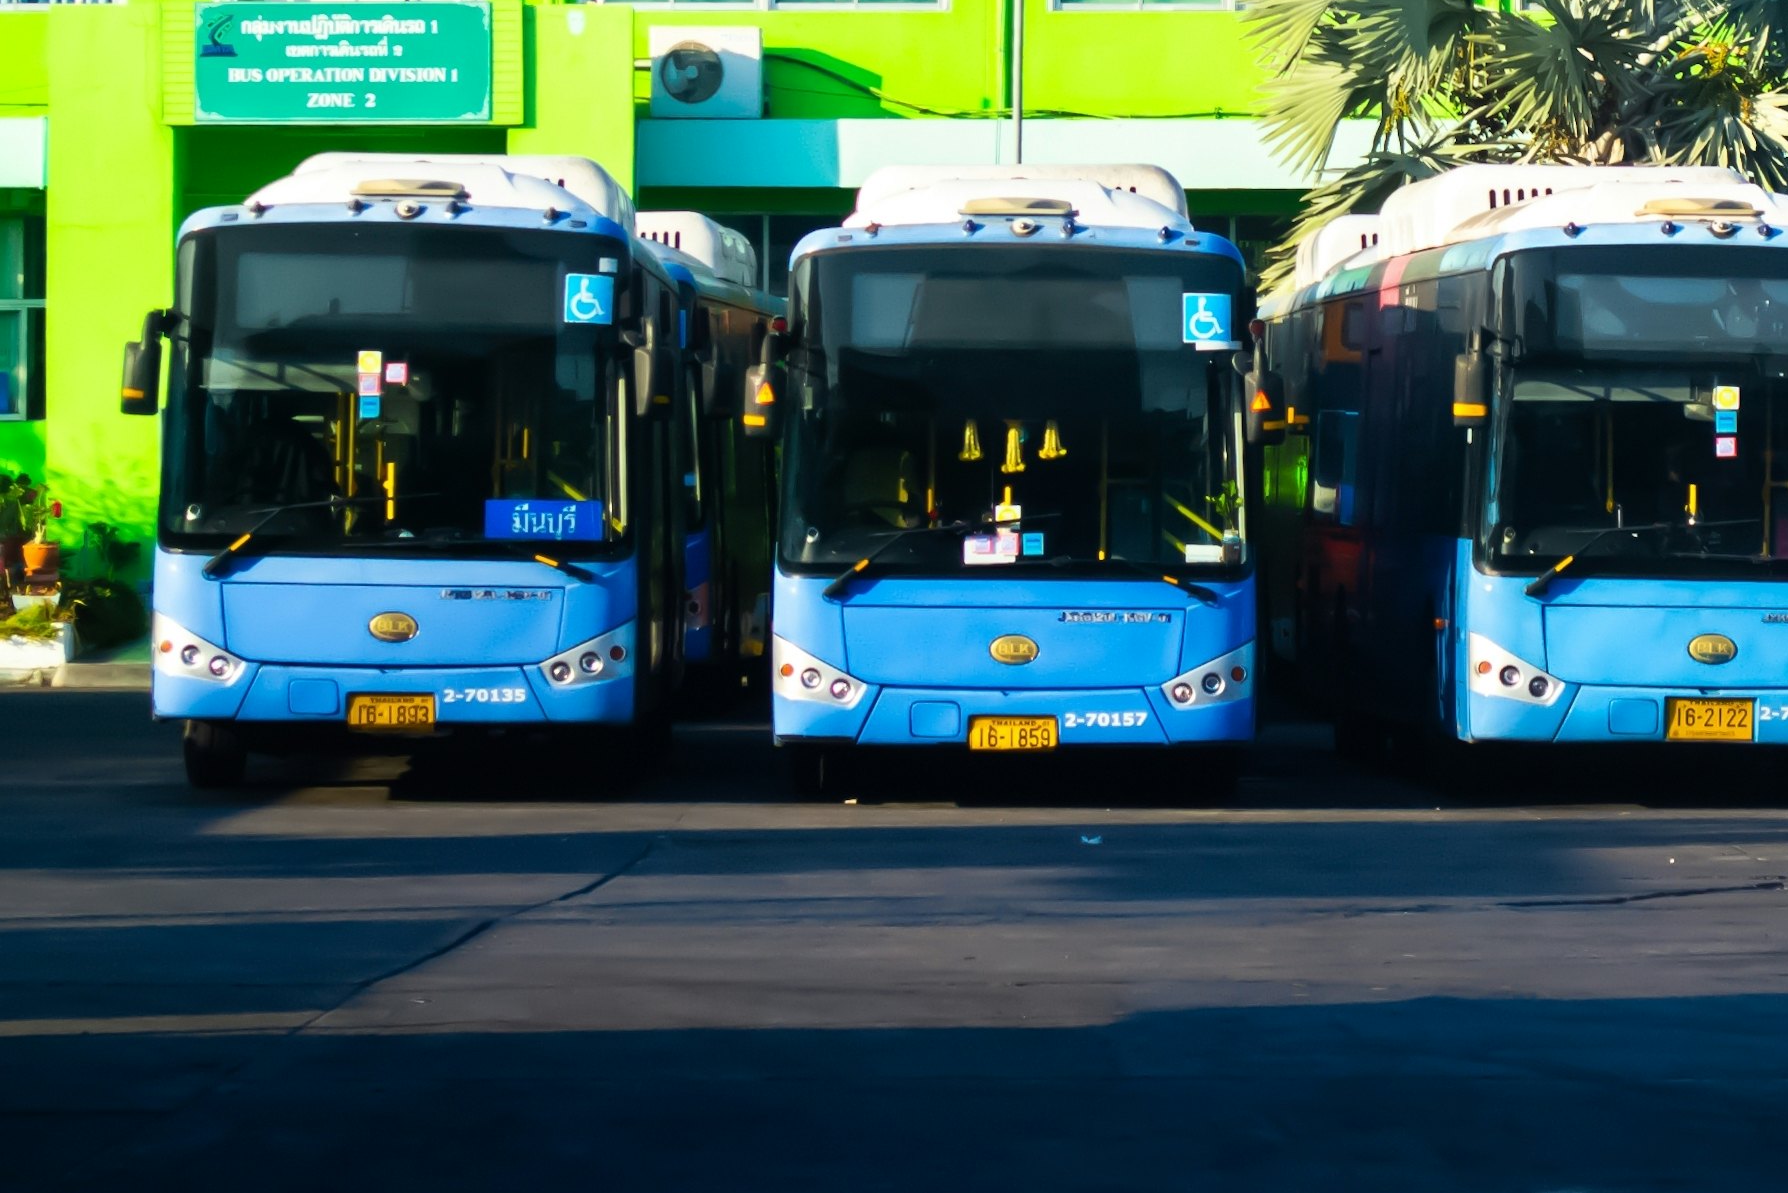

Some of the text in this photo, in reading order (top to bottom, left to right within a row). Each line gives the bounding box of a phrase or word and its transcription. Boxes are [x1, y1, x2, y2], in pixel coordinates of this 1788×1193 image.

[430, 19, 439, 34] 1
[228, 67, 459, 83] BUS OPERATION DIVISION 1
[306, 93, 377, 109] ZONE 2
[511, 502, 577, 540] มีนบุรี
[443, 688, 526, 703] 2-70135
[1064, 712, 1148, 727] 2-70157
[1677, 707, 1748, 728] 16-2122
[980, 727, 1051, 747] 16-1859
